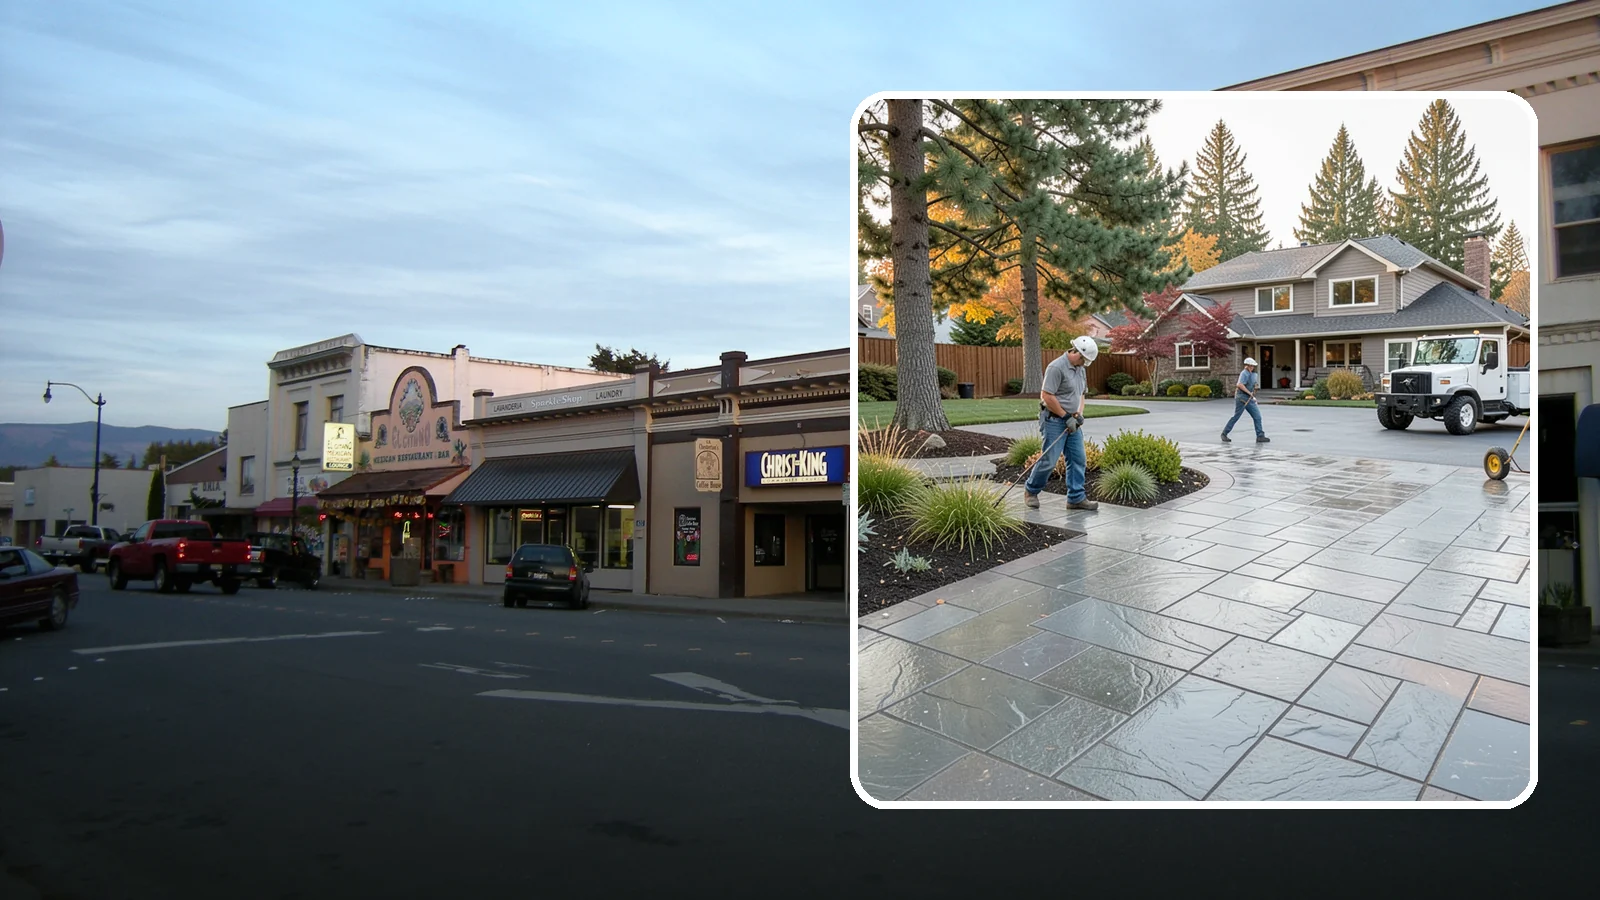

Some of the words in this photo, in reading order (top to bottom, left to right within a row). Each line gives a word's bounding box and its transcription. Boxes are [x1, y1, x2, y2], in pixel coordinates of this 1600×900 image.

[561, 394, 583, 404] Shop
[595, 389, 623, 400] LAUNDRY
[493, 402, 522, 412] LAVANDERIA
[373, 455, 396, 464] MEXICAN
[397, 451, 433, 462] RESTAURANT
[438, 450, 450, 459] BAR
[760, 451, 797, 478] CHRIST
[799, 449, 827, 476] KING
